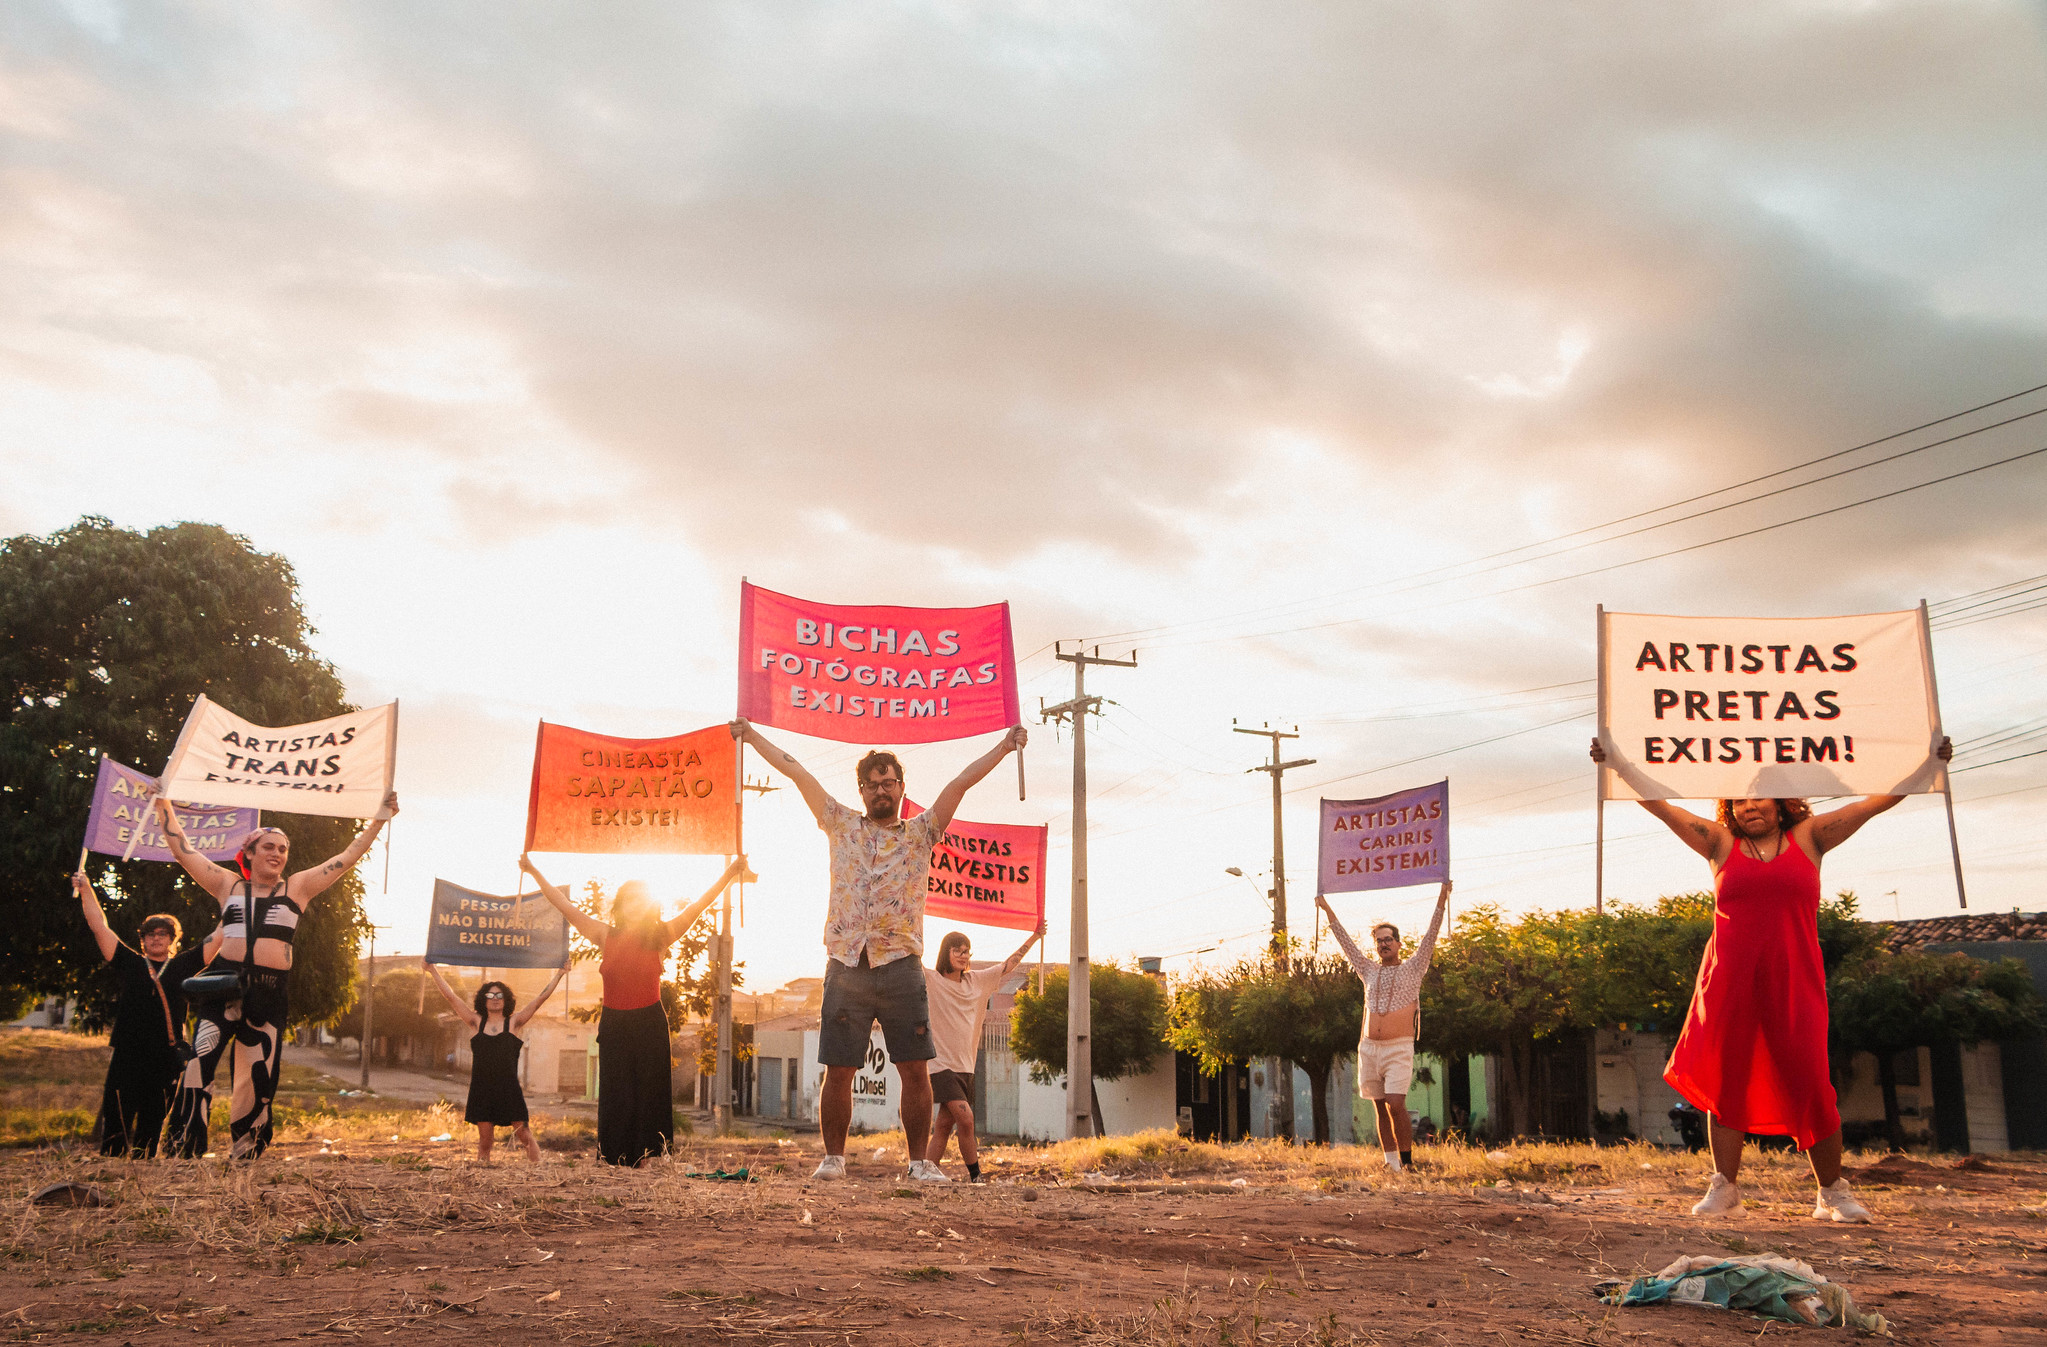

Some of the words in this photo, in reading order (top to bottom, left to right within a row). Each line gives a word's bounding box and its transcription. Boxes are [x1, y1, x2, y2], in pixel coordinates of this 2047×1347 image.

[796, 618, 960, 656] BICHAS
[761, 648, 997, 689] FOTÓGRAFAS
[1636, 641, 1857, 674] ARTISTAS
[790, 685, 950, 718] EXISTEM!
[1654, 689, 1841, 721] PRETAS
[222, 727, 356, 753] ARTISTAS
[1645, 735, 1855, 763] EXISTEM!
[225, 752, 342, 776] TRANS
[581, 749, 702, 769] CINEASTA
[567, 770, 713, 798] SAPATÃO
[113, 804, 237, 829] AUTSTAS
[591, 808, 680, 826] EXISTE!
[1333, 801, 1443, 832] ARTISTAS
[117, 826, 227, 849] EXISEM!
[940, 832, 1012, 857] RTISTAS
[1359, 829, 1434, 851] CARIRIS
[1336, 849, 1438, 875] EXISTEM!
[927, 876, 1005, 903] EXISTEM!
[438, 911, 473, 927] NÃO
[459, 932, 531, 947] EXISTEM!
